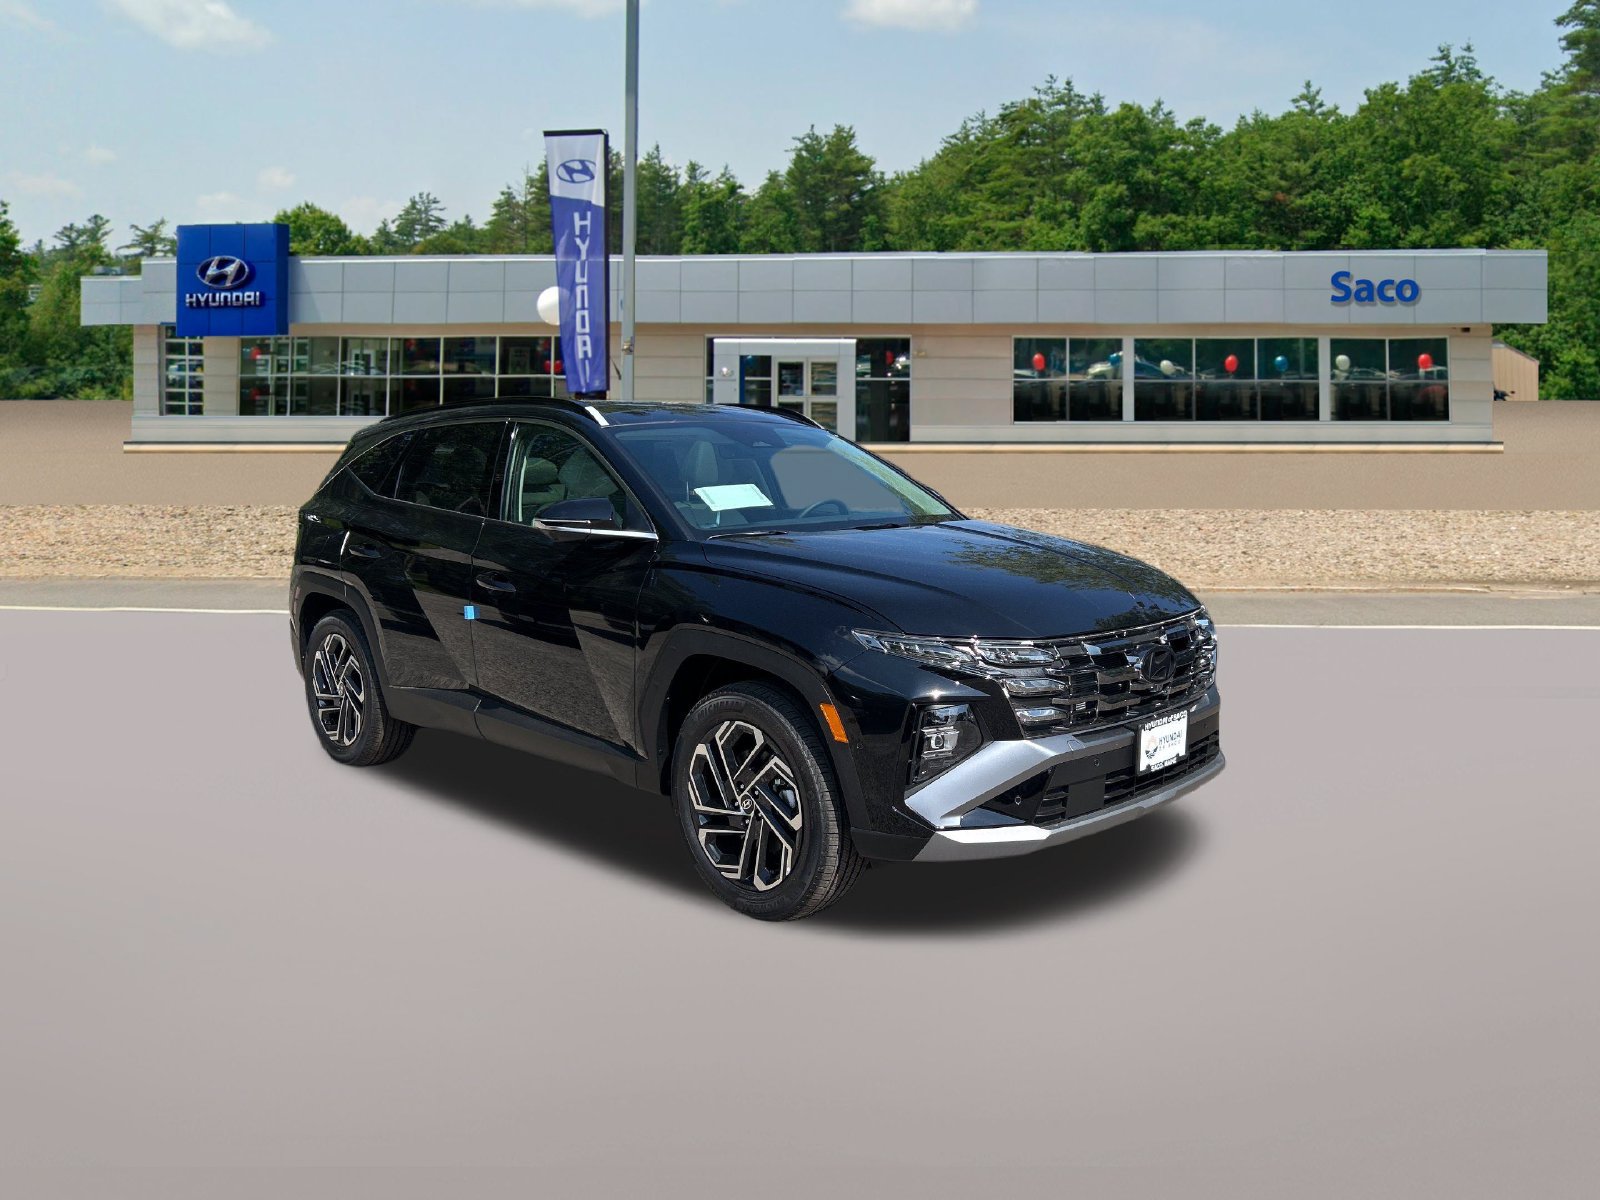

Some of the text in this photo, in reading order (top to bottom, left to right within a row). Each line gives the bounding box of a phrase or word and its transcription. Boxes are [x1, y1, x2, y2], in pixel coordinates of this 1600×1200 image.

[573, 211, 592, 383] HYUNDAI
[1330, 270, 1420, 303] Saco
[185, 291, 261, 308] HYUNDAI
[1158, 729, 1183, 745] HYUNDAI
